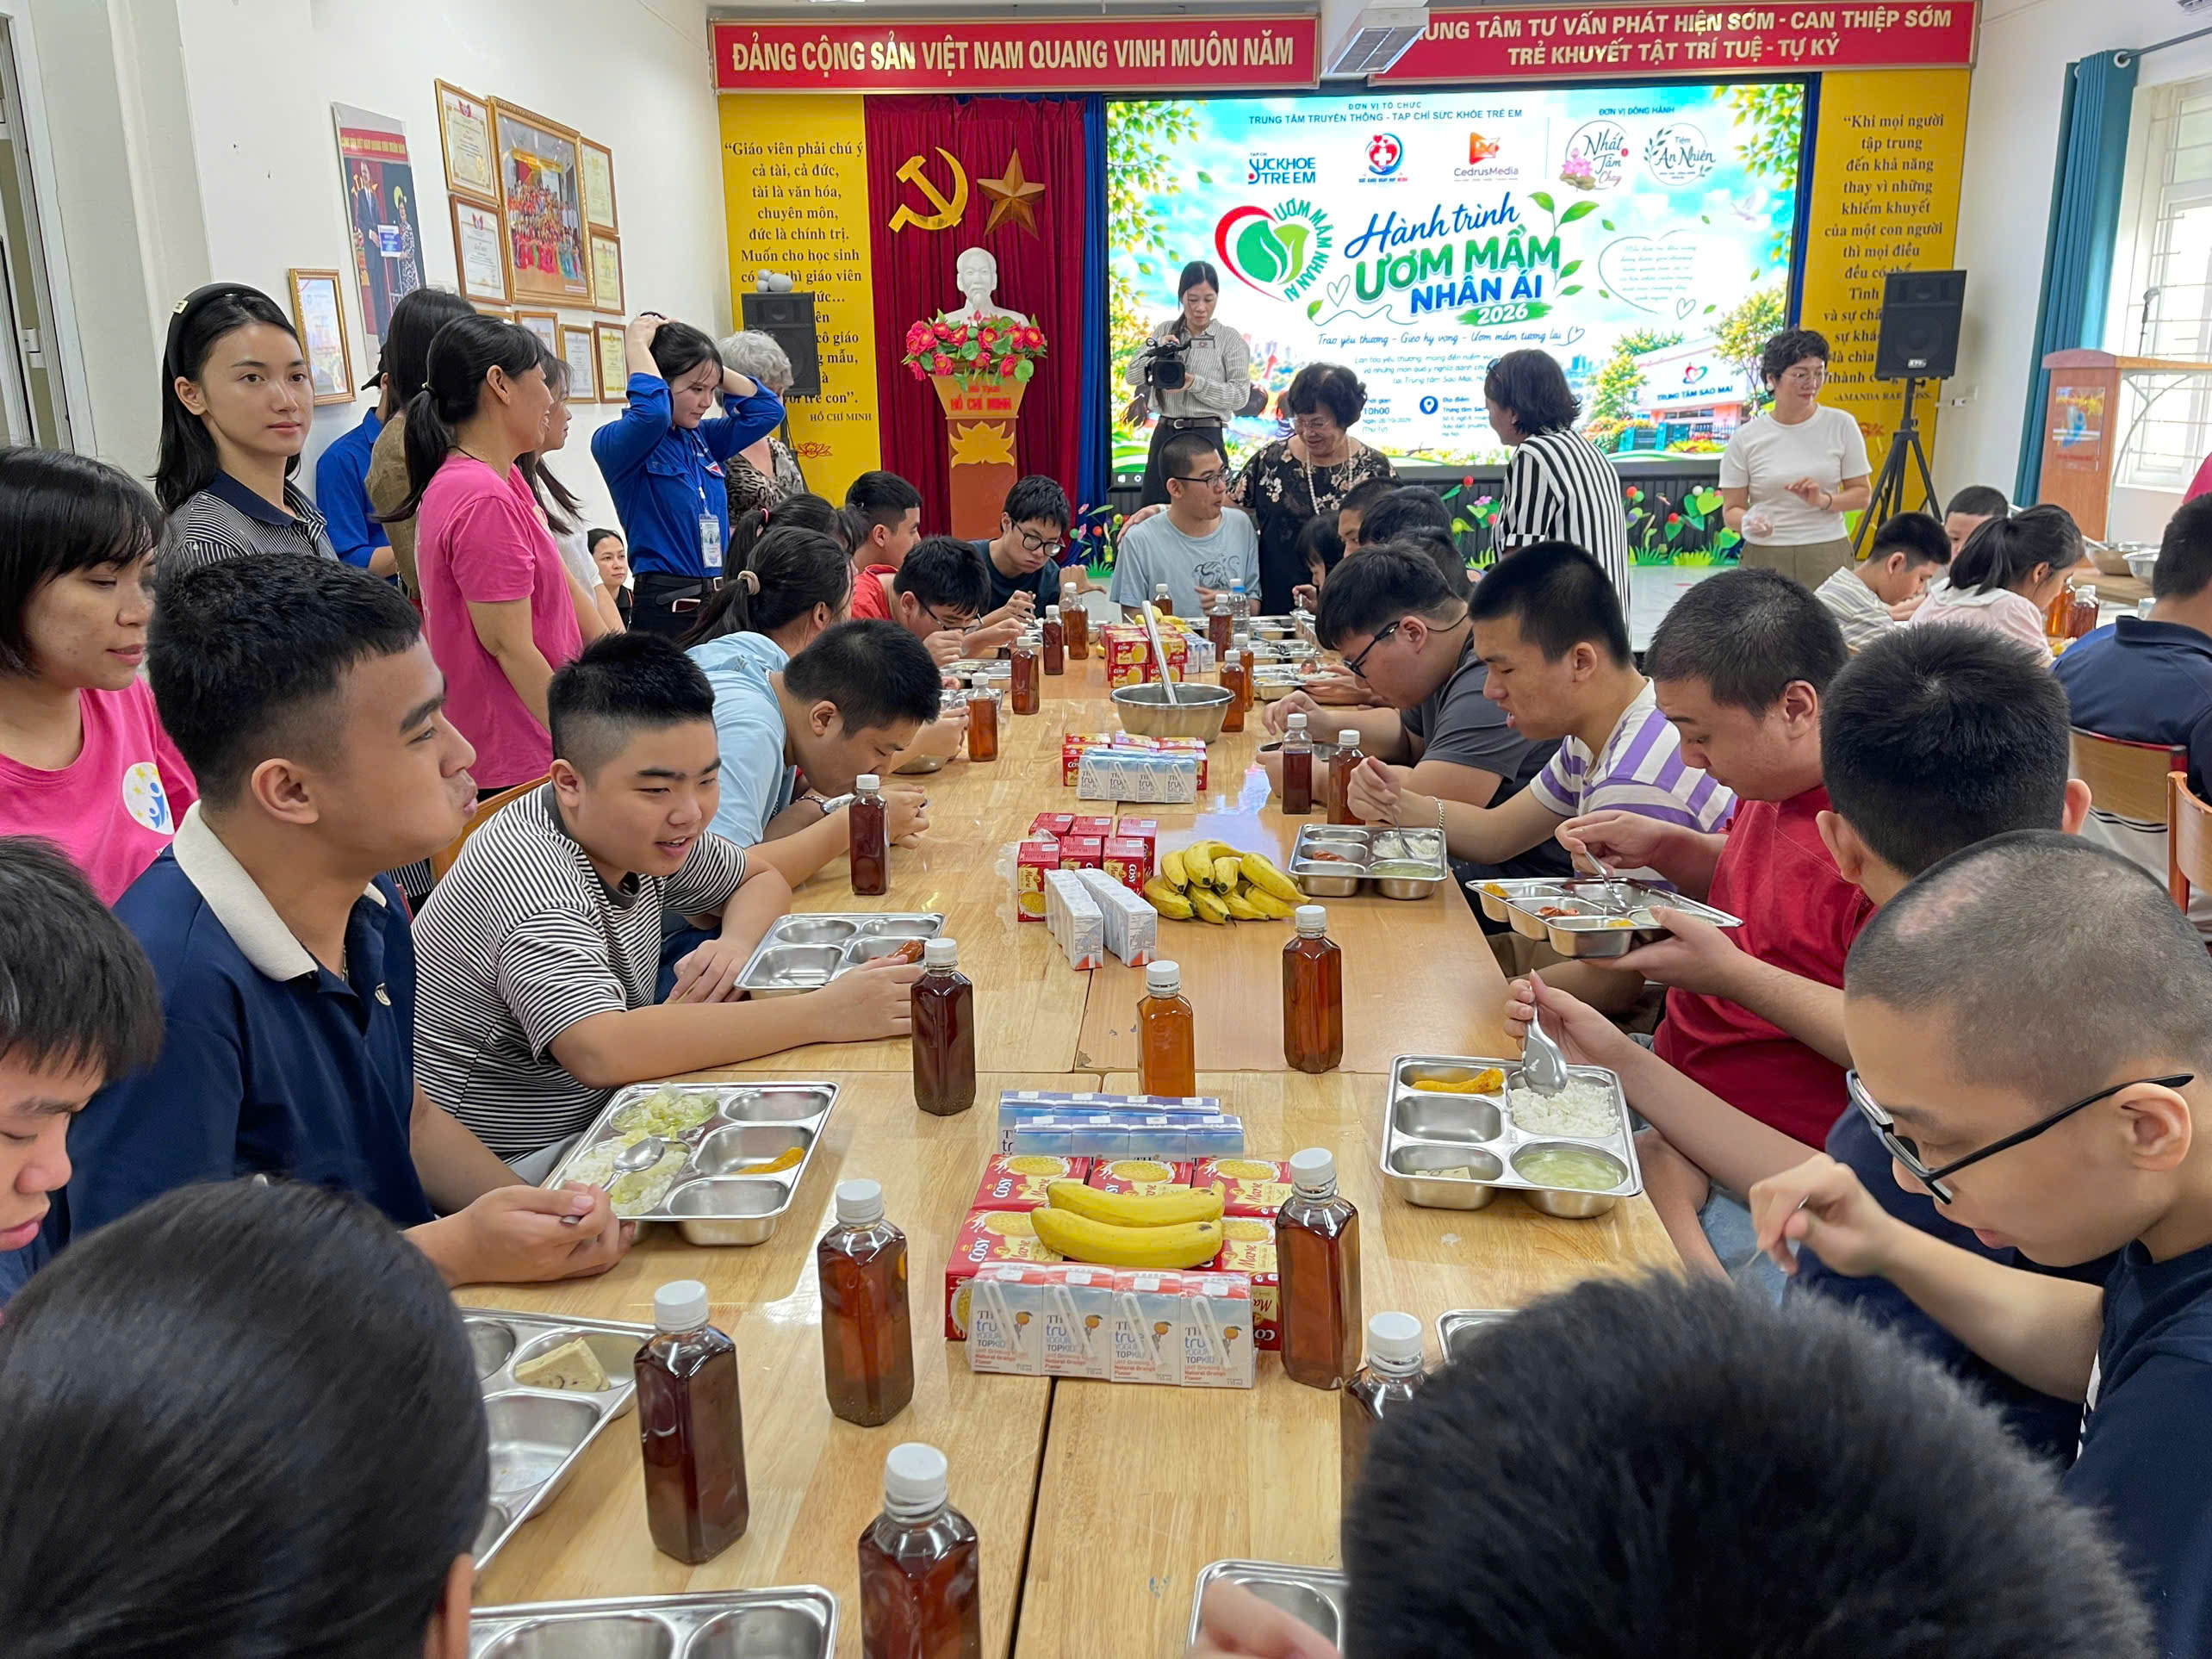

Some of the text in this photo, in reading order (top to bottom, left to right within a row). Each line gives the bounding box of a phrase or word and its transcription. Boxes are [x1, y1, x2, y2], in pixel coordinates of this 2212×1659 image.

[1419, 5, 1952, 40] UNG TÂM TƯ VẤN PHÁT HIỆN SỚM CAN THIỆP SỚM
[732, 29, 1293, 78] ĐẢNG CỘNG SẢN VIỆT NAM QUANG VINH MUÔN NĂM
[1508, 31, 1840, 65] TRẺ KHUYẾT TẬT TRÍ TUỆ TỰ KỶ
[1250, 115, 1283, 124] TRUNG
[1285, 113, 1305, 123] TÂM
[1351, 111, 1383, 122] THÔNG
[1508, 109, 1523, 118] EM
[1880, 115, 1904, 130] mọi
[1908, 114, 1944, 130] người
[767, 141, 792, 154] viên
[798, 141, 826, 158] phải
[830, 141, 853, 155] chú
[856, 141, 863, 157] ý
[1861, 136, 1923, 152] tập trung
[752, 163, 839, 178] cả tài, cả đức,
[1454, 166, 1519, 177] CedrusMedia
[1846, 156, 1869, 172] đến
[1902, 158, 1934, 173] năng
[1293, 171, 1316, 183] EM
[753, 185, 842, 199] tài là văn hóa,
[1843, 179, 1933, 196] thay vì những
[758, 206, 838, 222] chuyên môn,
[1842, 198, 1930, 216] khiếm khuyết
[1344, 191, 1520, 258] Hành trình
[1824, 222, 1943, 239] của một con người
[749, 227, 849, 243] đức là chính trị.
[741, 246, 860, 264] Muốn cho học sinh
[1842, 241, 1920, 260] thì mọi điều
[1355, 242, 1453, 301] ƯƠM
[1464, 223, 1561, 273] MẦM
[741, 269, 861, 285] có hì giáo viên
[1845, 264, 1867, 279] đều
[1872, 265, 1886, 279] có
[1410, 270, 1543, 314] NHÂN ÁI
[1476, 302, 1529, 326] 2026
[1824, 308, 1856, 324] và sự
[834, 331, 859, 345] giáo
[1318, 332, 1337, 345] Trao
[1835, 329, 1876, 345] sự khá
[828, 350, 859, 365] mẫu,
[810, 411, 873, 422] HỒ CHÍ MINH
[1128, 864, 1137, 883] COSY
[992, 1177, 1013, 1198] COSY
[1104, 1183, 1119, 1195] SY
[968, 1237, 991, 1263] COSY
[976, 1320, 997, 1332] tru
[1047, 1324, 1067, 1336] tru
[1185, 1336, 1206, 1349] tru
[1254, 1328, 1276, 1341] CO
